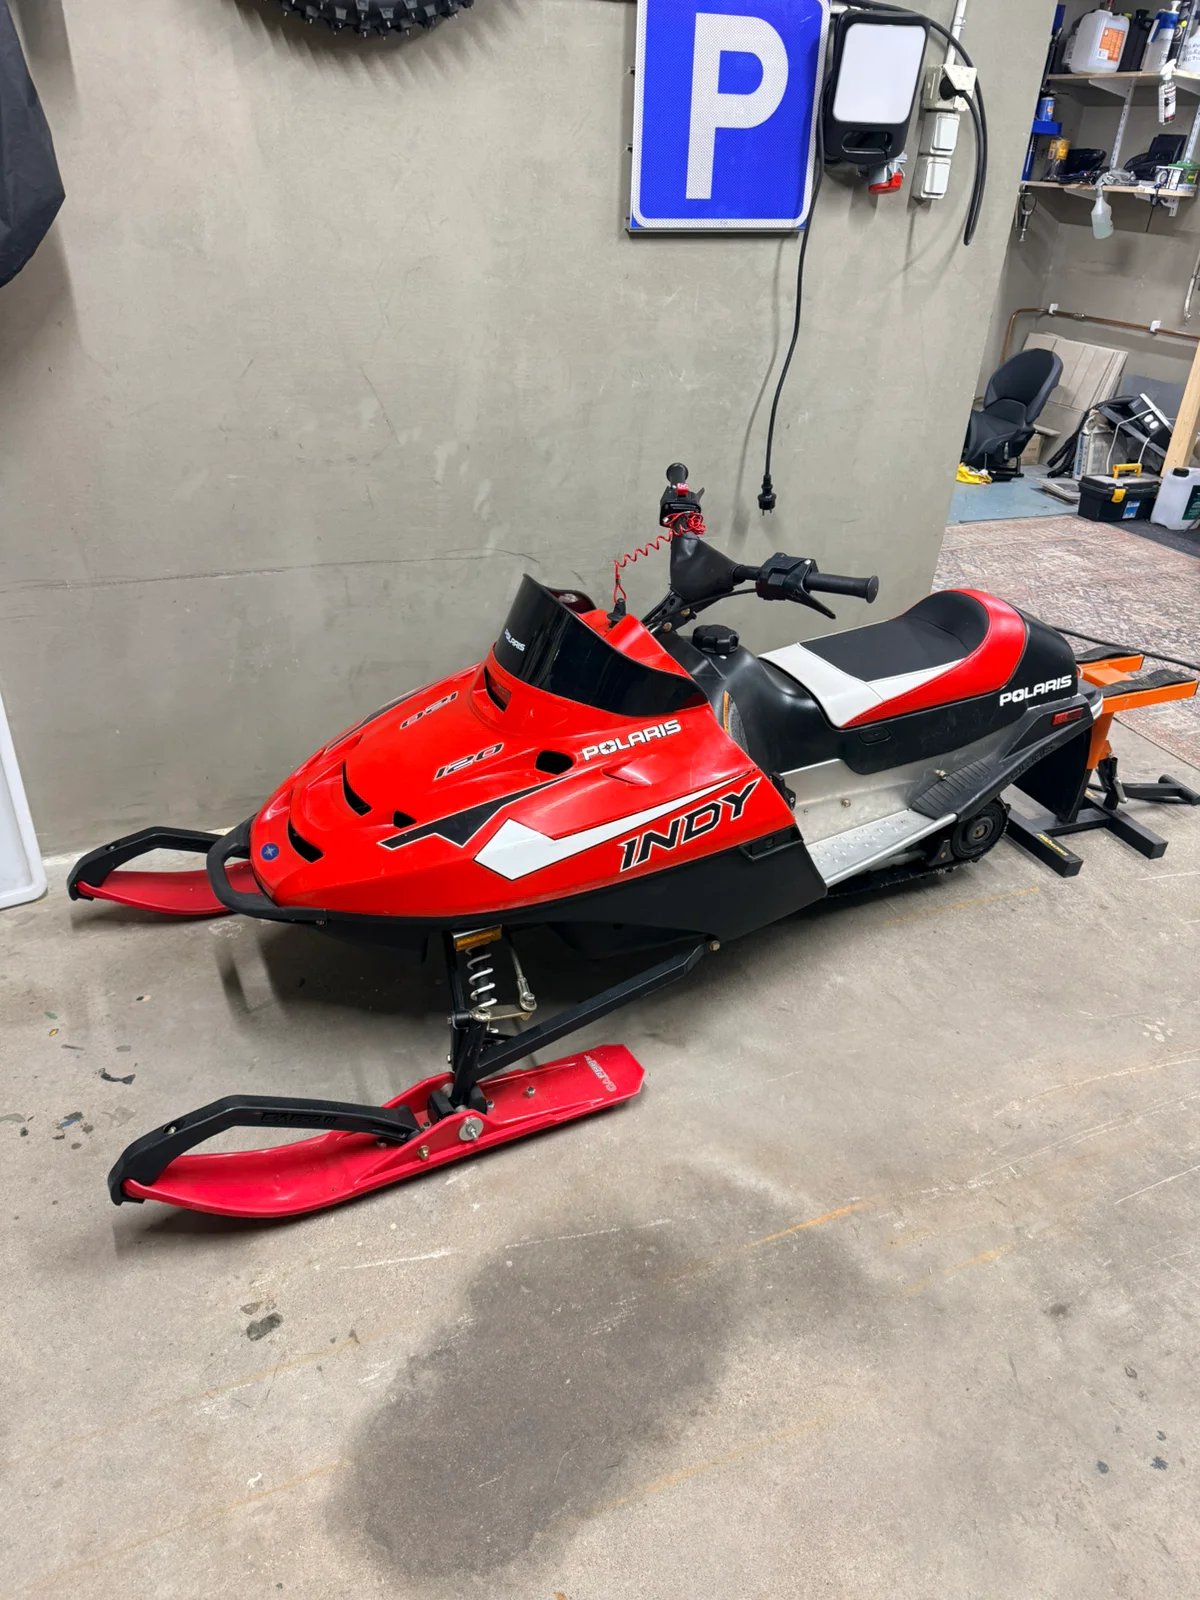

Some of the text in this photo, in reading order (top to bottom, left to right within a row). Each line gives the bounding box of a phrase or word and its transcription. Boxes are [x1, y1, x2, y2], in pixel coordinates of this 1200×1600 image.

[686, 12, 789, 200] P
[1000, 675, 1072, 706] POLARIS
[582, 719, 682, 761] POLARIS
[433, 742, 504, 781] 120
[617, 776, 763, 873] INDY
